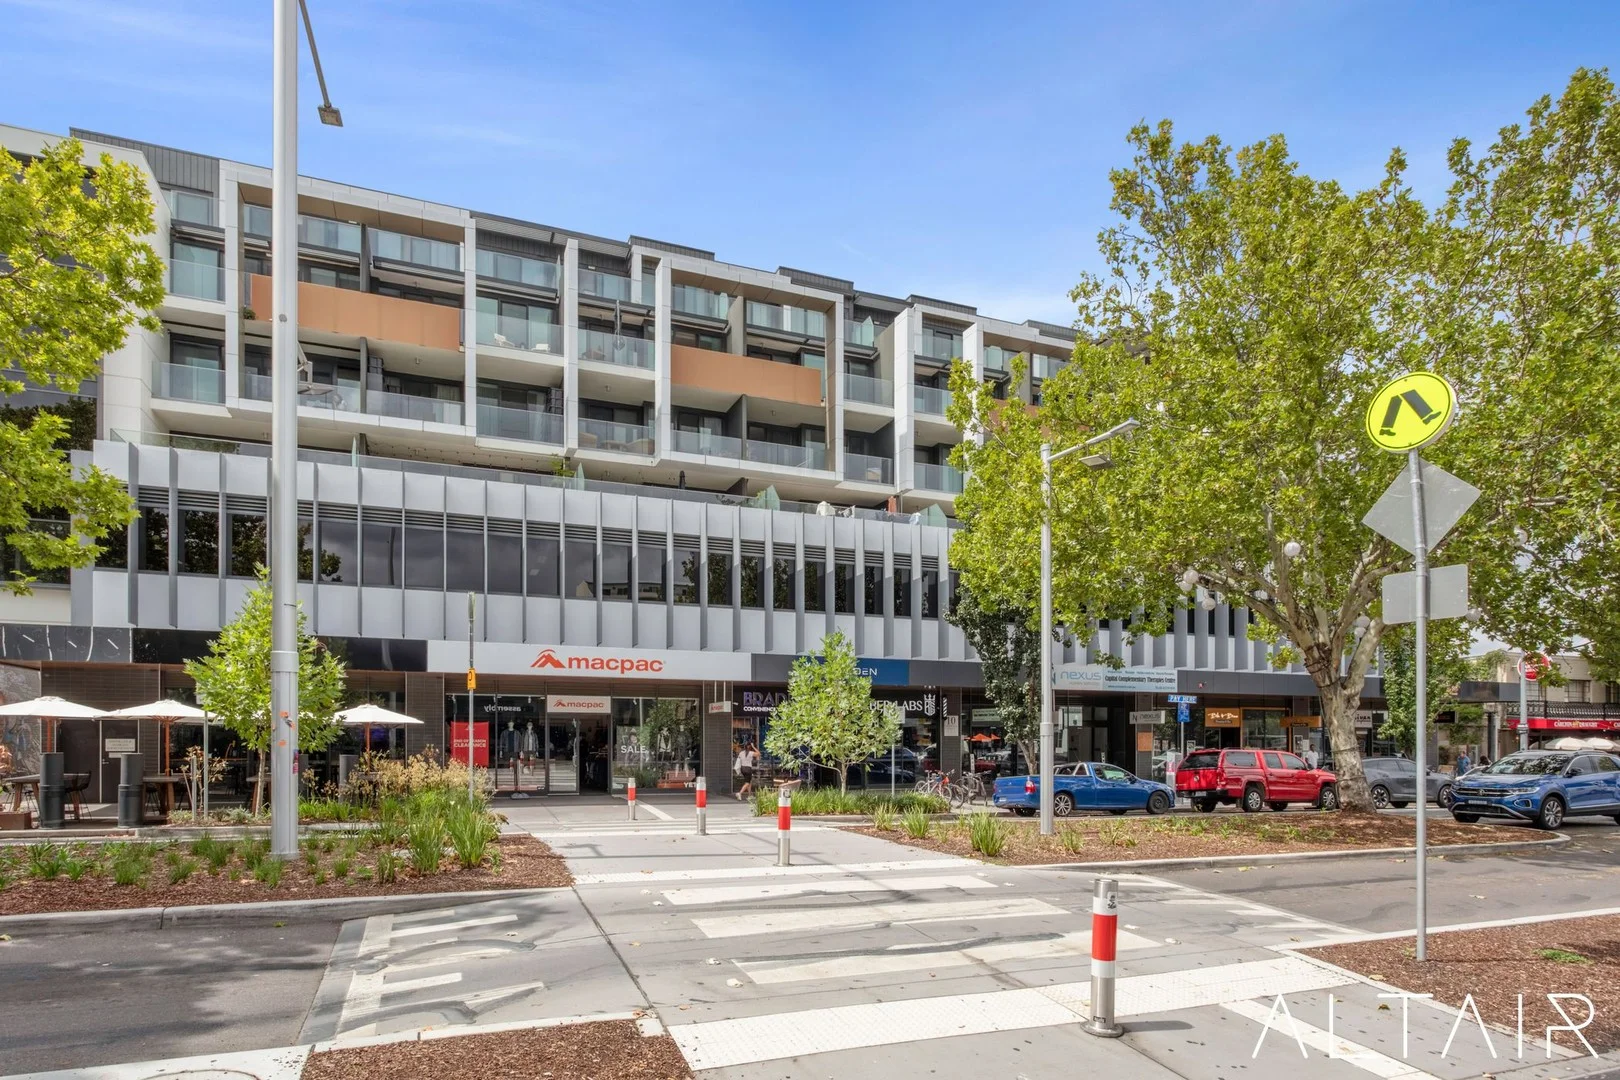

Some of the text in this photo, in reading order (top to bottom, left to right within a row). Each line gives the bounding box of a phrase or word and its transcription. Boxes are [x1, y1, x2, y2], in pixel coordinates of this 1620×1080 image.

[568, 656, 664, 675] macpac
[1060, 670, 1102, 681] nexus
[743, 691, 792, 707] BRAD
[567, 701, 604, 709] macpac
[620, 744, 647, 754] SALE
